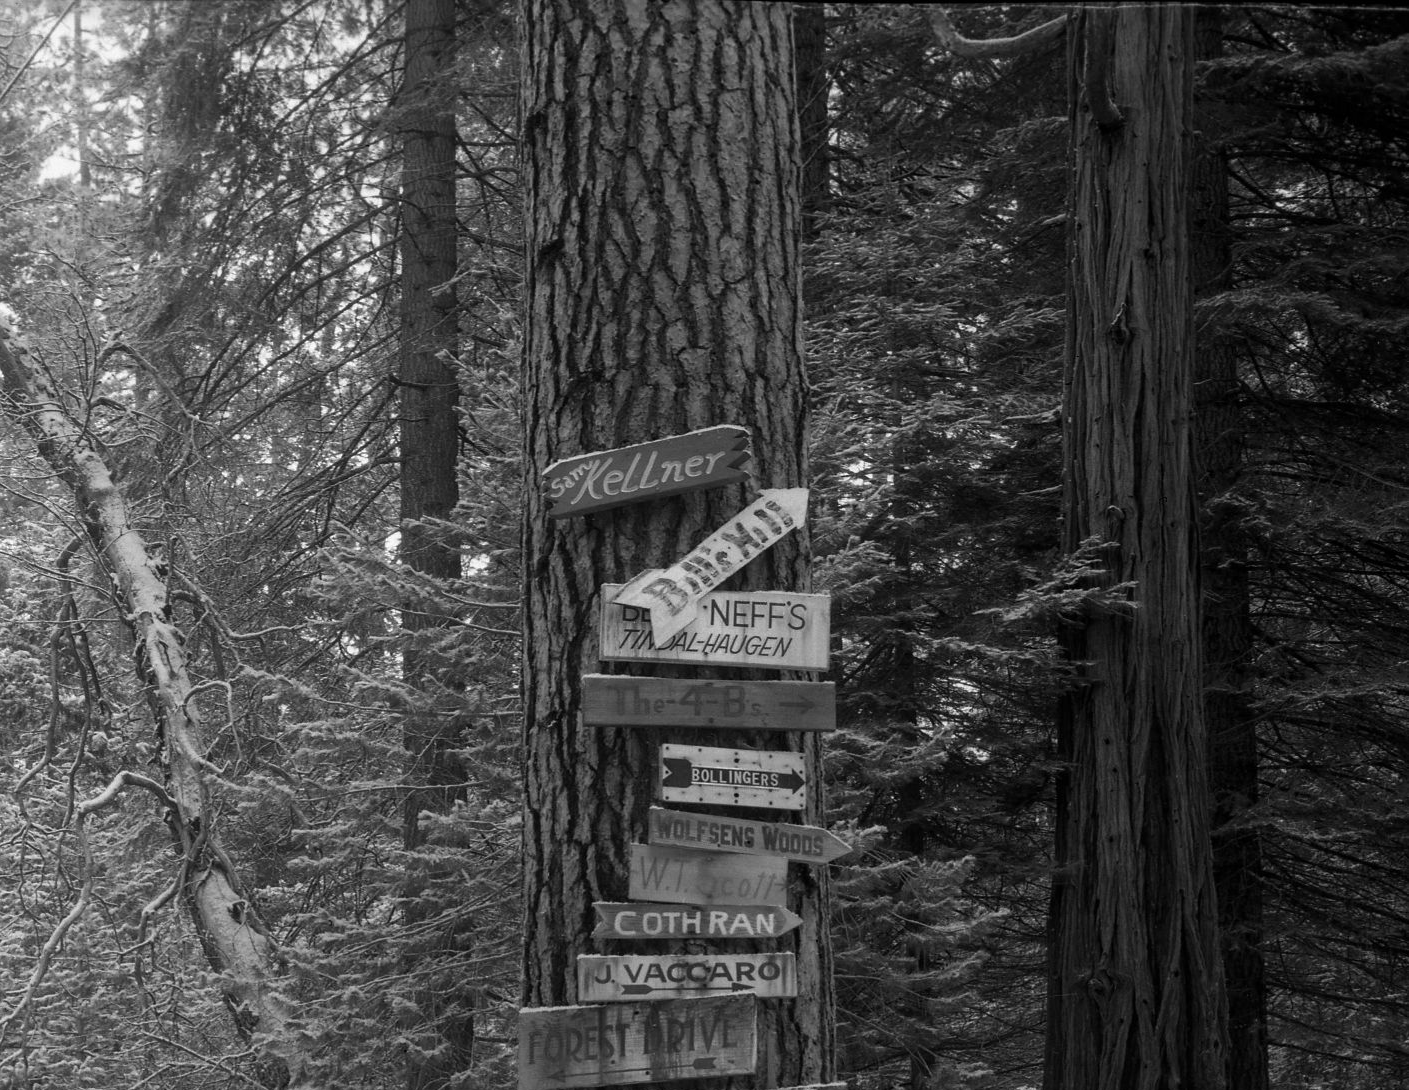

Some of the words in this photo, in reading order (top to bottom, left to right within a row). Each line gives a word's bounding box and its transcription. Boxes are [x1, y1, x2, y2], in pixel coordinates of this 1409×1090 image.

[571, 449, 727, 505] Kellner
[691, 769, 780, 787] BOLLINGERS
[657, 815, 756, 848] WOLFSENS
[762, 825, 824, 856] WOODS
[614, 910, 776, 936] COTHRAN
[594, 964, 616, 985] J.
[624, 962, 781, 984] VACCARO
[528, 1020, 630, 1065] FOREST
[643, 1013, 738, 1055] DRIVE
